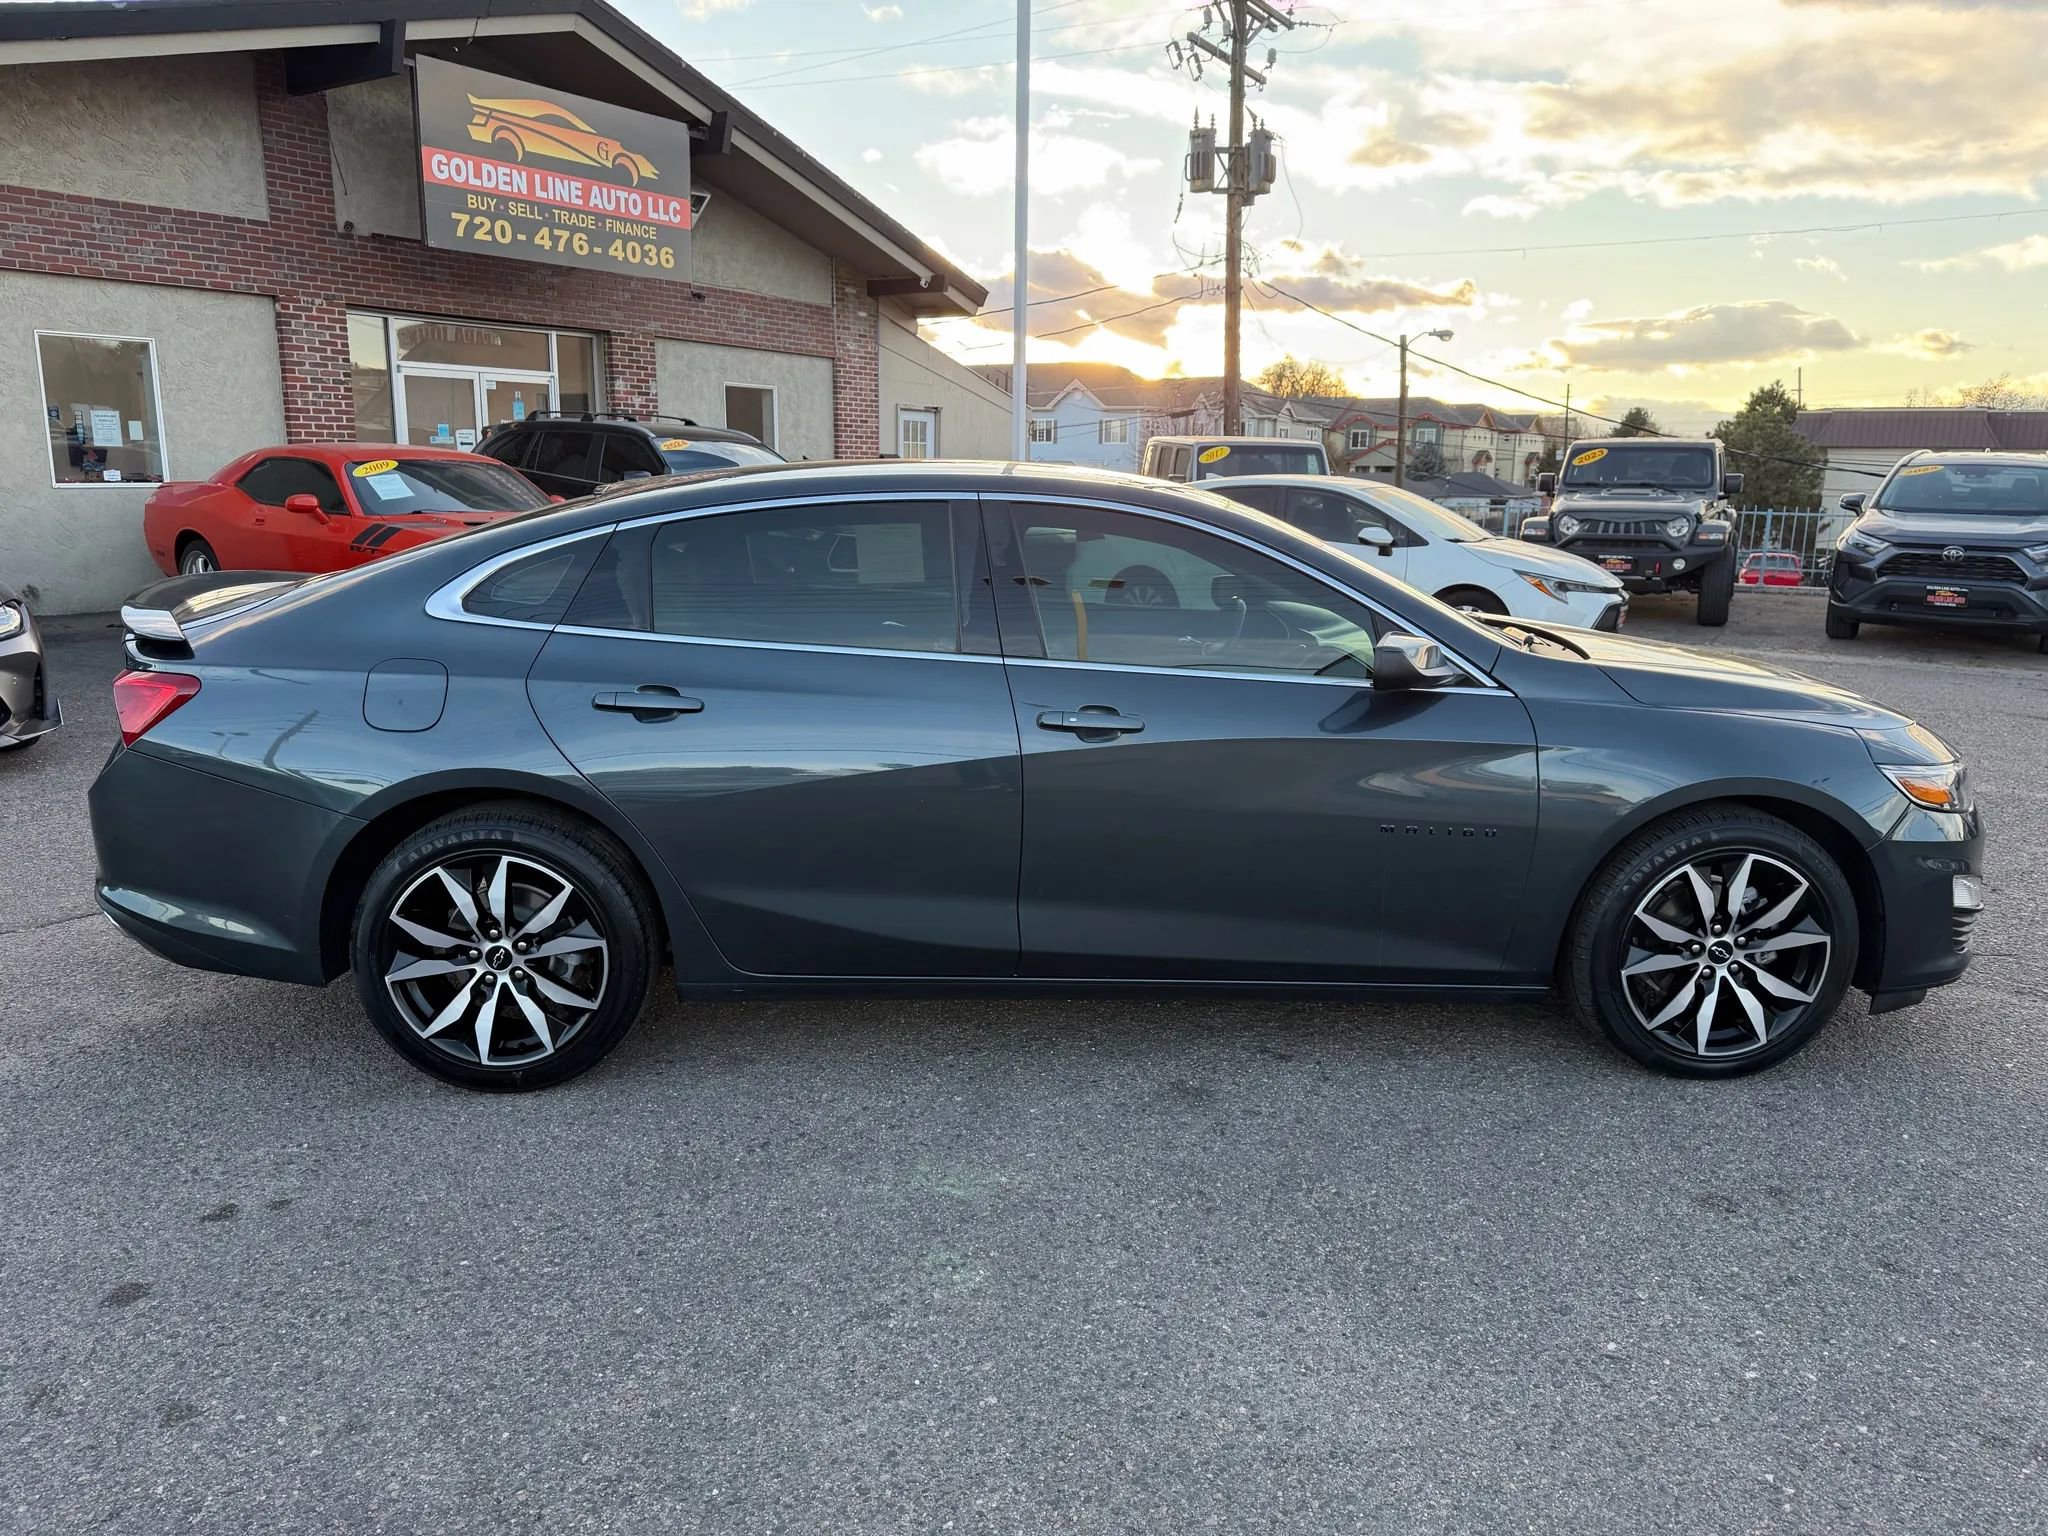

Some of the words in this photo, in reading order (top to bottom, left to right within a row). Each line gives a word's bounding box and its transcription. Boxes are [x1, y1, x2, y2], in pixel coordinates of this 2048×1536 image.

[431, 153, 528, 195] GOLDEN
[534, 173, 583, 205] LINE
[589, 185, 642, 217] AUTO
[647, 196, 681, 224] LLC
[467, 194, 497, 213] BUY
[508, 201, 543, 221] SELL
[552, 208, 596, 230] TRADE
[605, 219, 657, 240] FINANCE
[1577, 449, 1605, 465] 2023
[361, 461, 390, 475] 2009
[349, 544, 378, 555] R/T
[1380, 824, 1497, 838] MALIBU
[408, 829, 503, 863] ADVANTA
